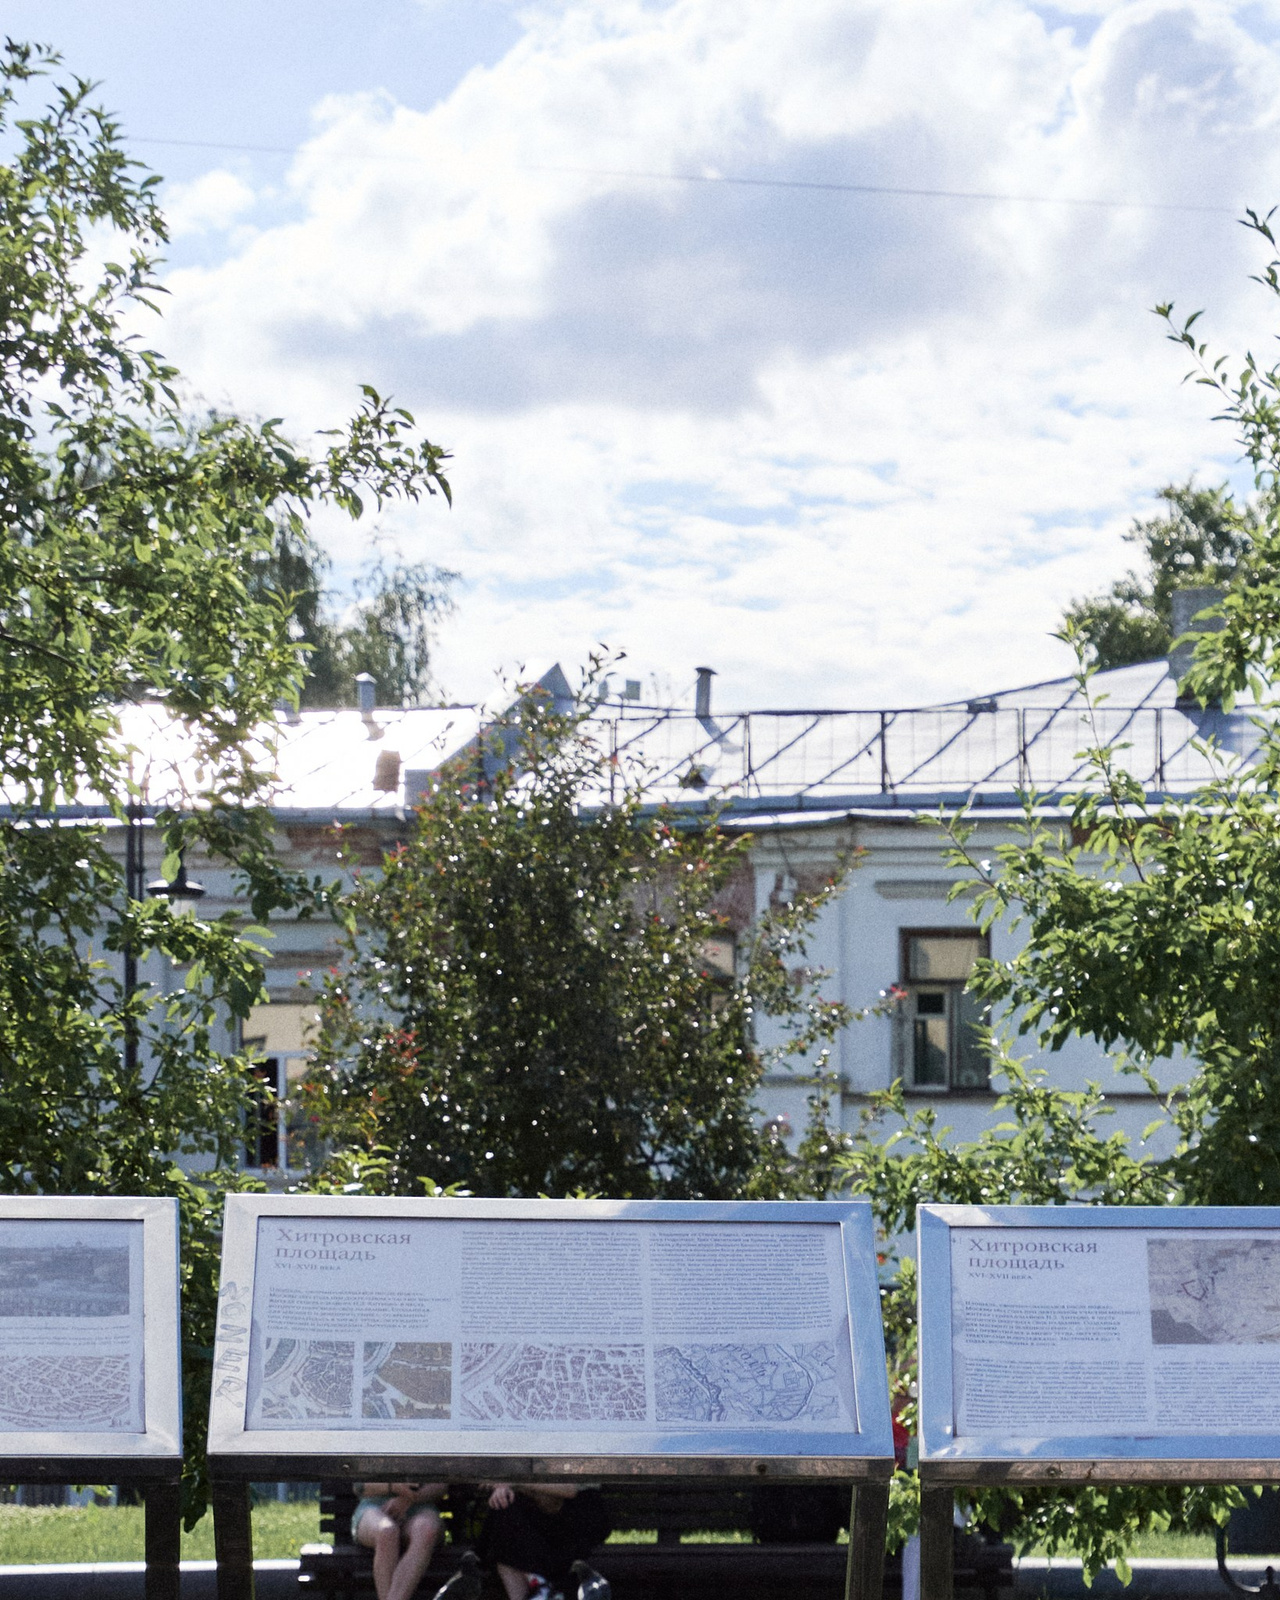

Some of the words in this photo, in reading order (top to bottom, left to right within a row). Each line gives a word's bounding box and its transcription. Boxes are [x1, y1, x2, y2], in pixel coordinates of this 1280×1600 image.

[277, 1228, 411, 1247] Хитровская
[275, 1248, 376, 1262] площадь
[968, 1238, 1098, 1256] Хитровская
[968, 1257, 1065, 1271] площадь
